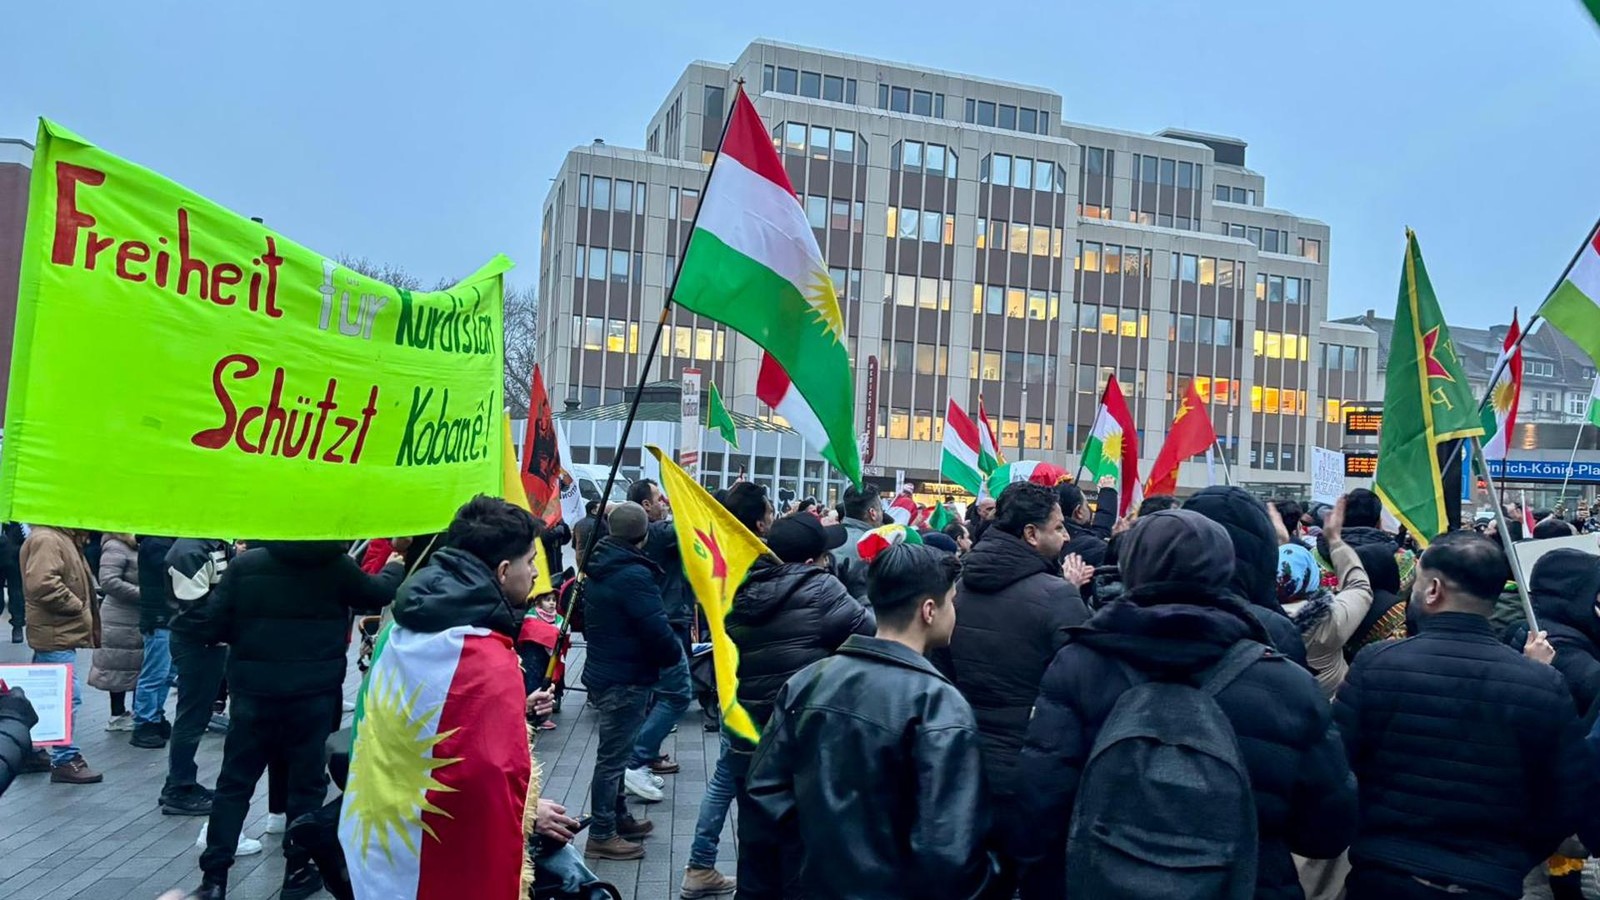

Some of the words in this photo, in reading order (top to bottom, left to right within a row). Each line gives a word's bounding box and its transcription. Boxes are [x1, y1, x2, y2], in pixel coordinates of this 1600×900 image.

[51, 161, 284, 319] Freiheit
[318, 257, 390, 340] für
[394, 285, 497, 355] Kurdistan
[190, 353, 381, 466] Schützt
[395, 385, 495, 467] Kobanê!
